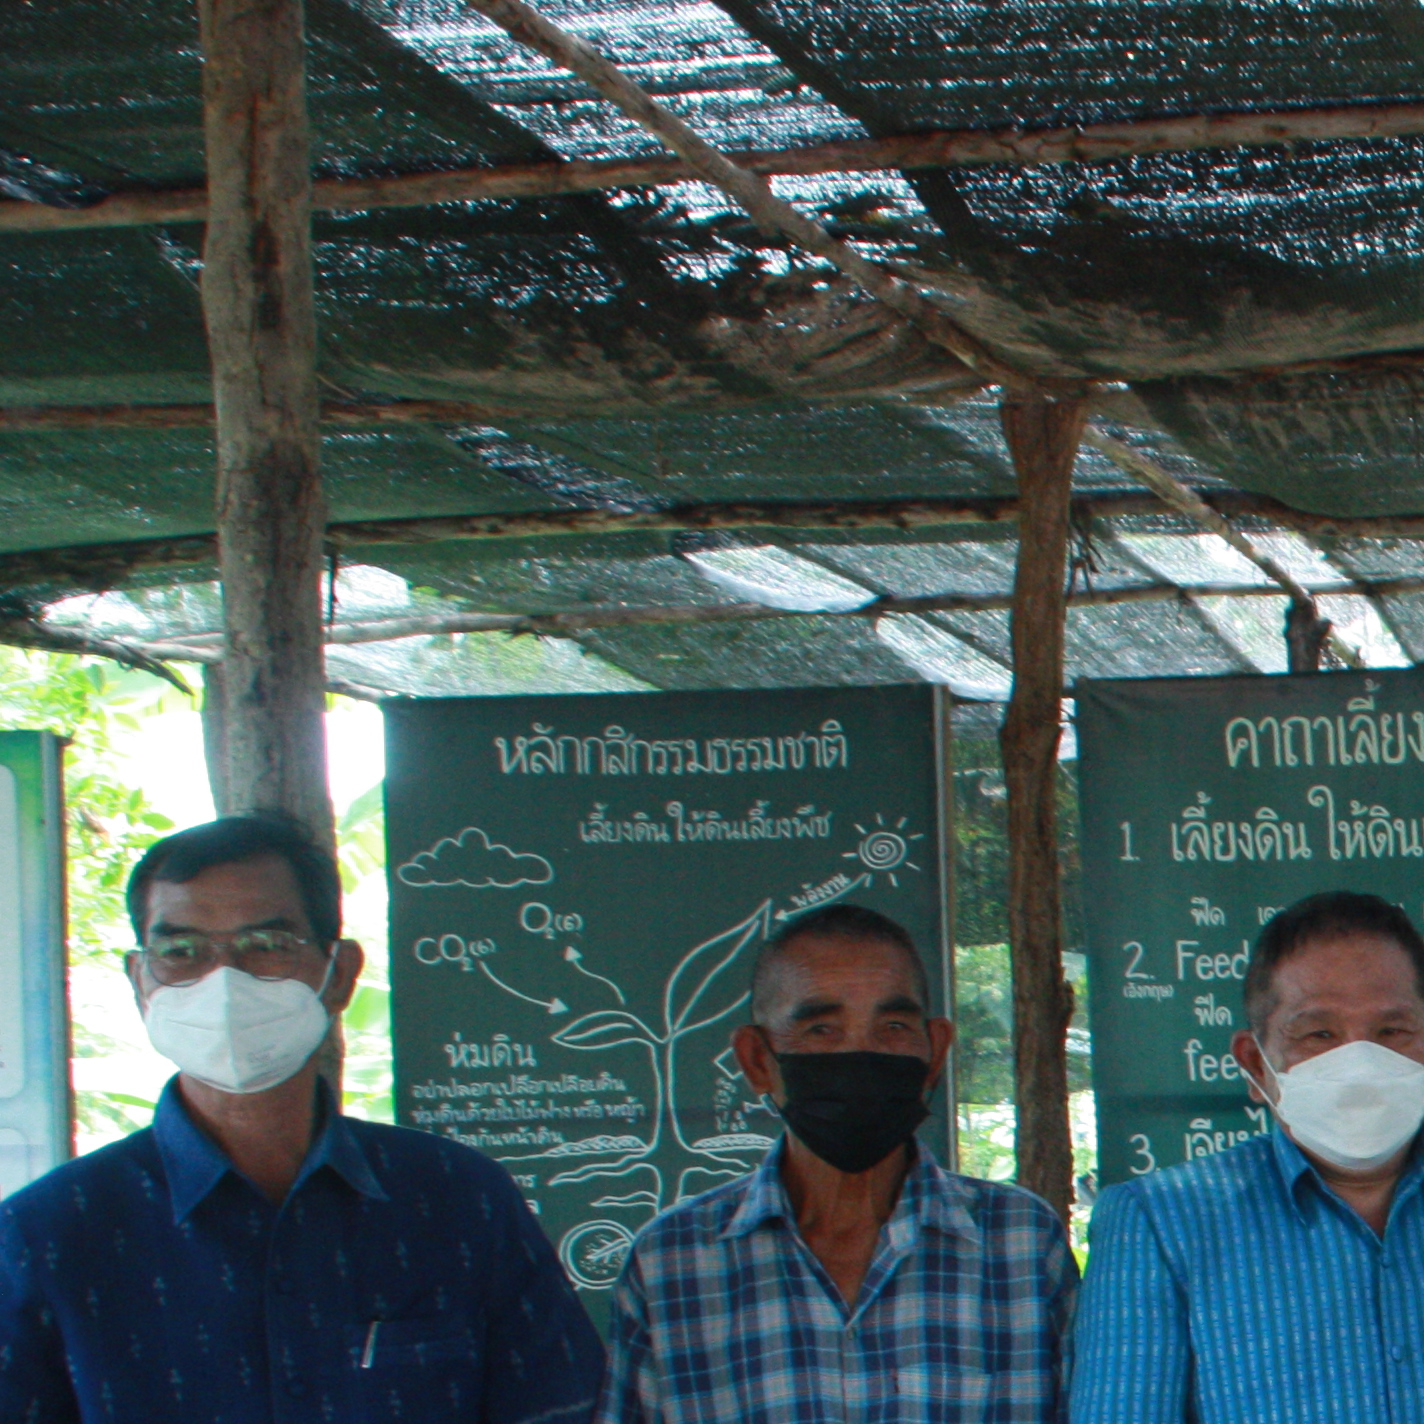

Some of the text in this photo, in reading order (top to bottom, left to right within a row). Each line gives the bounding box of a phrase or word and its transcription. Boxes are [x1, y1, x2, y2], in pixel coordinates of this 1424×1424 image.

[494, 719, 848, 775] หลักกสิกรรมธรรมชาติ
[579, 800, 833, 843] เลี้ยงดิน ให้ดินเลี้ยงพืช
[1170, 791, 1312, 862] เลี้ยงดิน
[1175, 939, 1250, 980] Feed
[444, 1031, 538, 1069] ห่มดิน
[1184, 1039, 1247, 1082] fee
